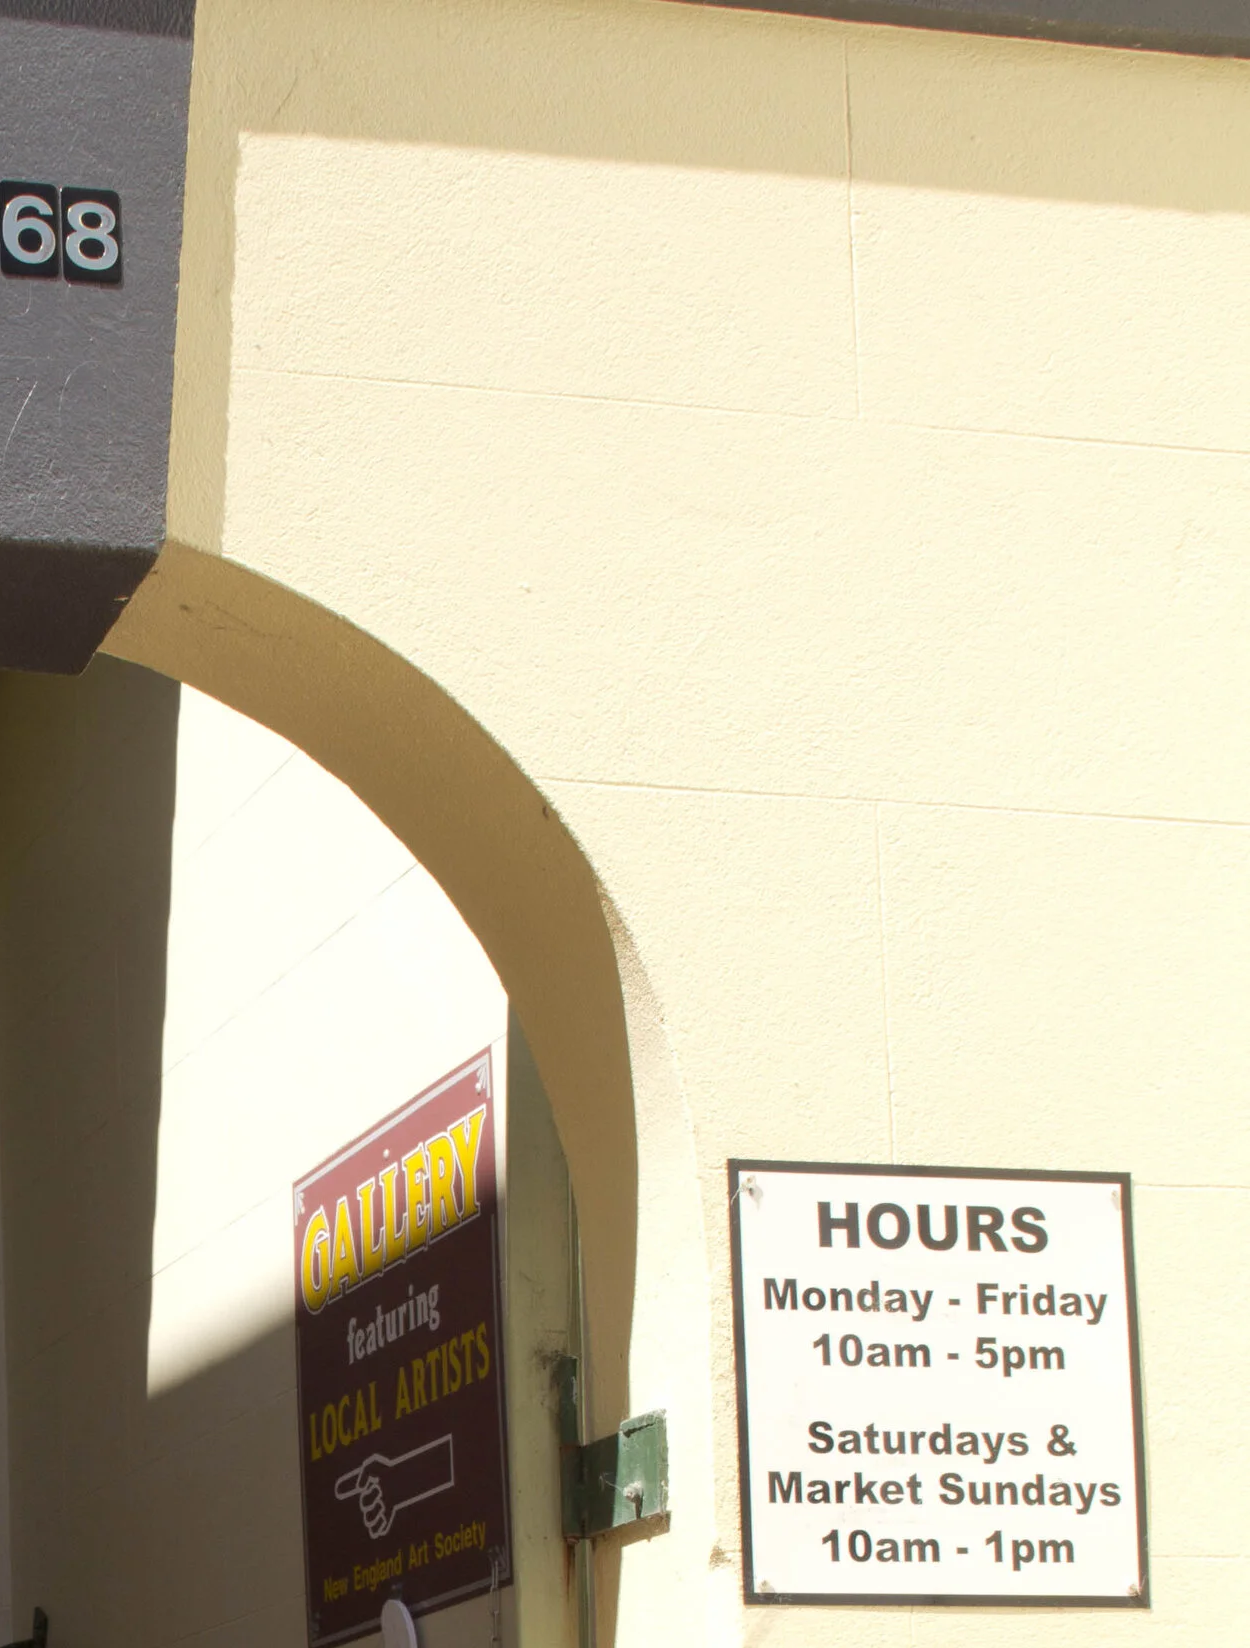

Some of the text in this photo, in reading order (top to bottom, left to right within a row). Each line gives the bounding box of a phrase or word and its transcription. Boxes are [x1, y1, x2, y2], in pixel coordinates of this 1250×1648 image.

[301, 1104, 485, 1314] GALLERY
[817, 1201, 1049, 1253] HOURS
[347, 1285, 440, 1364] featuring
[763, 1278, 933, 1321] Monday
[976, 1283, 1108, 1325] Friday
[812, 1333, 932, 1367] 10am
[975, 1337, 1066, 1377] 5pm
[310, 1321, 491, 1461] LOCAL ARTISTS
[808, 1421, 1078, 1464] Saturdays &
[768, 1471, 1121, 1515] Market Sundays
[324, 1520, 487, 1602] New England Art Society
[821, 1529, 941, 1563] 10am
[985, 1530, 1075, 1571] 1pm
